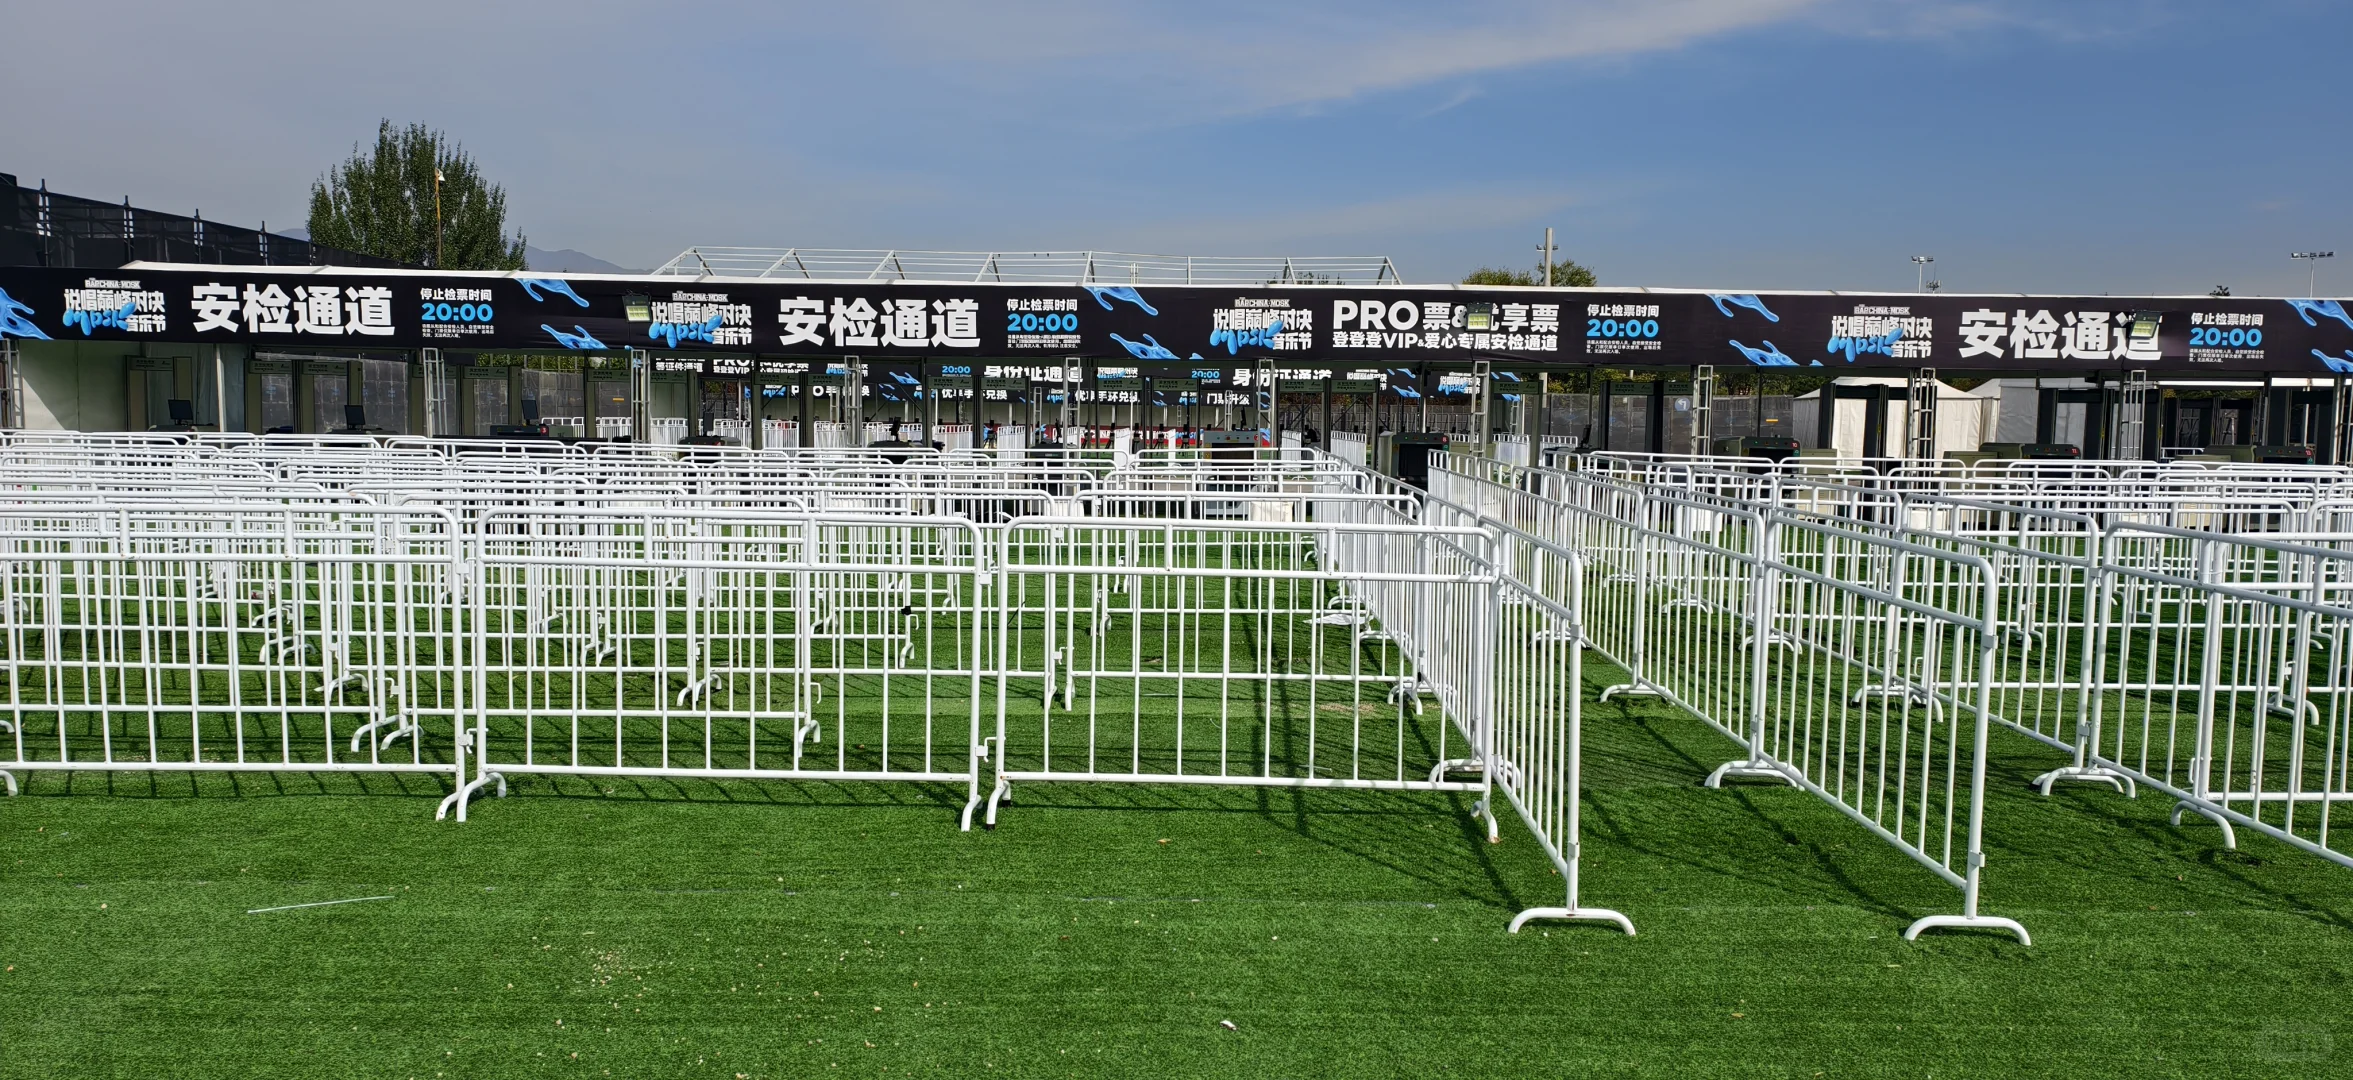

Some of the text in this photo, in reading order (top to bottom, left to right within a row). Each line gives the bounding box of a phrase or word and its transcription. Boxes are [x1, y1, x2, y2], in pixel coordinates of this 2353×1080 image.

[64, 289, 166, 313] 说唱巅峰对决
[420, 288, 492, 302] 停止检票时间
[191, 282, 396, 336] 安检通道
[421, 302, 493, 321] 20:00
[651, 302, 752, 325] 说唱巅峰对决
[1007, 298, 1078, 311] 停止检票时间
[1587, 304, 1659, 317] 停止检票时间
[126, 315, 166, 332] 音乐节
[778, 296, 981, 347] 安检通道
[1007, 313, 1078, 331] 20:00
[1213, 308, 1312, 330] 说唱巅峰对决
[1586, 319, 1659, 337] 20:00
[1832, 315, 1933, 338] 说唱巅峰对决
[2191, 312, 2263, 326] 停止检票时间
[712, 327, 752, 345] 音乐节
[1272, 332, 1312, 350] 音乐节
[1332, 331, 1558, 351] 登登登VIP&爱心专属安检通道
[1958, 308, 2163, 361] 安检通道
[2189, 327, 2262, 346] 20:00
[1891, 340, 1932, 358] 音乐节
[942, 365, 971, 374] 20:00
[1191, 370, 1220, 379] 20:00
